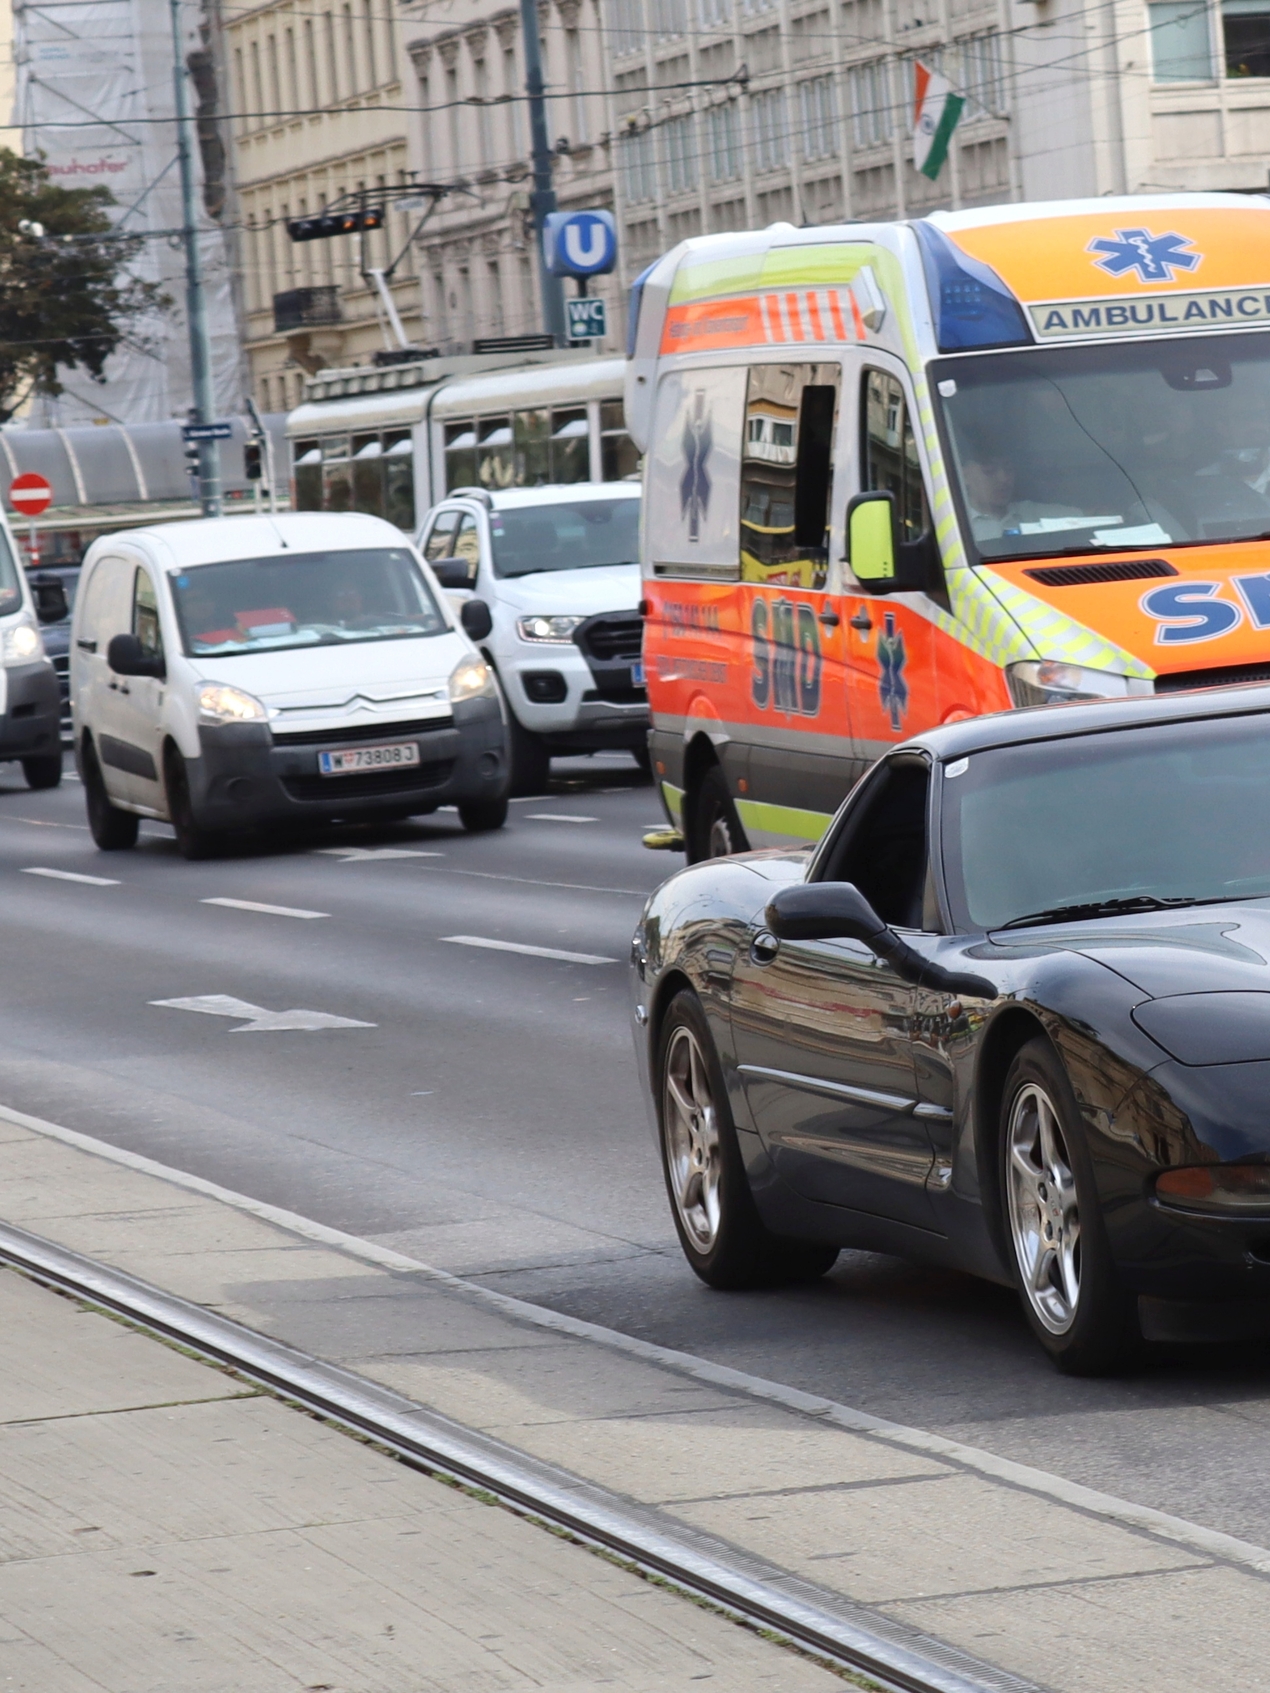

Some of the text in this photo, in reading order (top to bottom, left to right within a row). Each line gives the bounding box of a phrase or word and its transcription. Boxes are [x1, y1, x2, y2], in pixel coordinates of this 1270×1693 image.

[565, 223, 606, 267] U
[569, 301, 603, 321] WC
[752, 596, 822, 717] SMD
[355, 747, 402, 767] 73808
[404, 746, 414, 761] J
